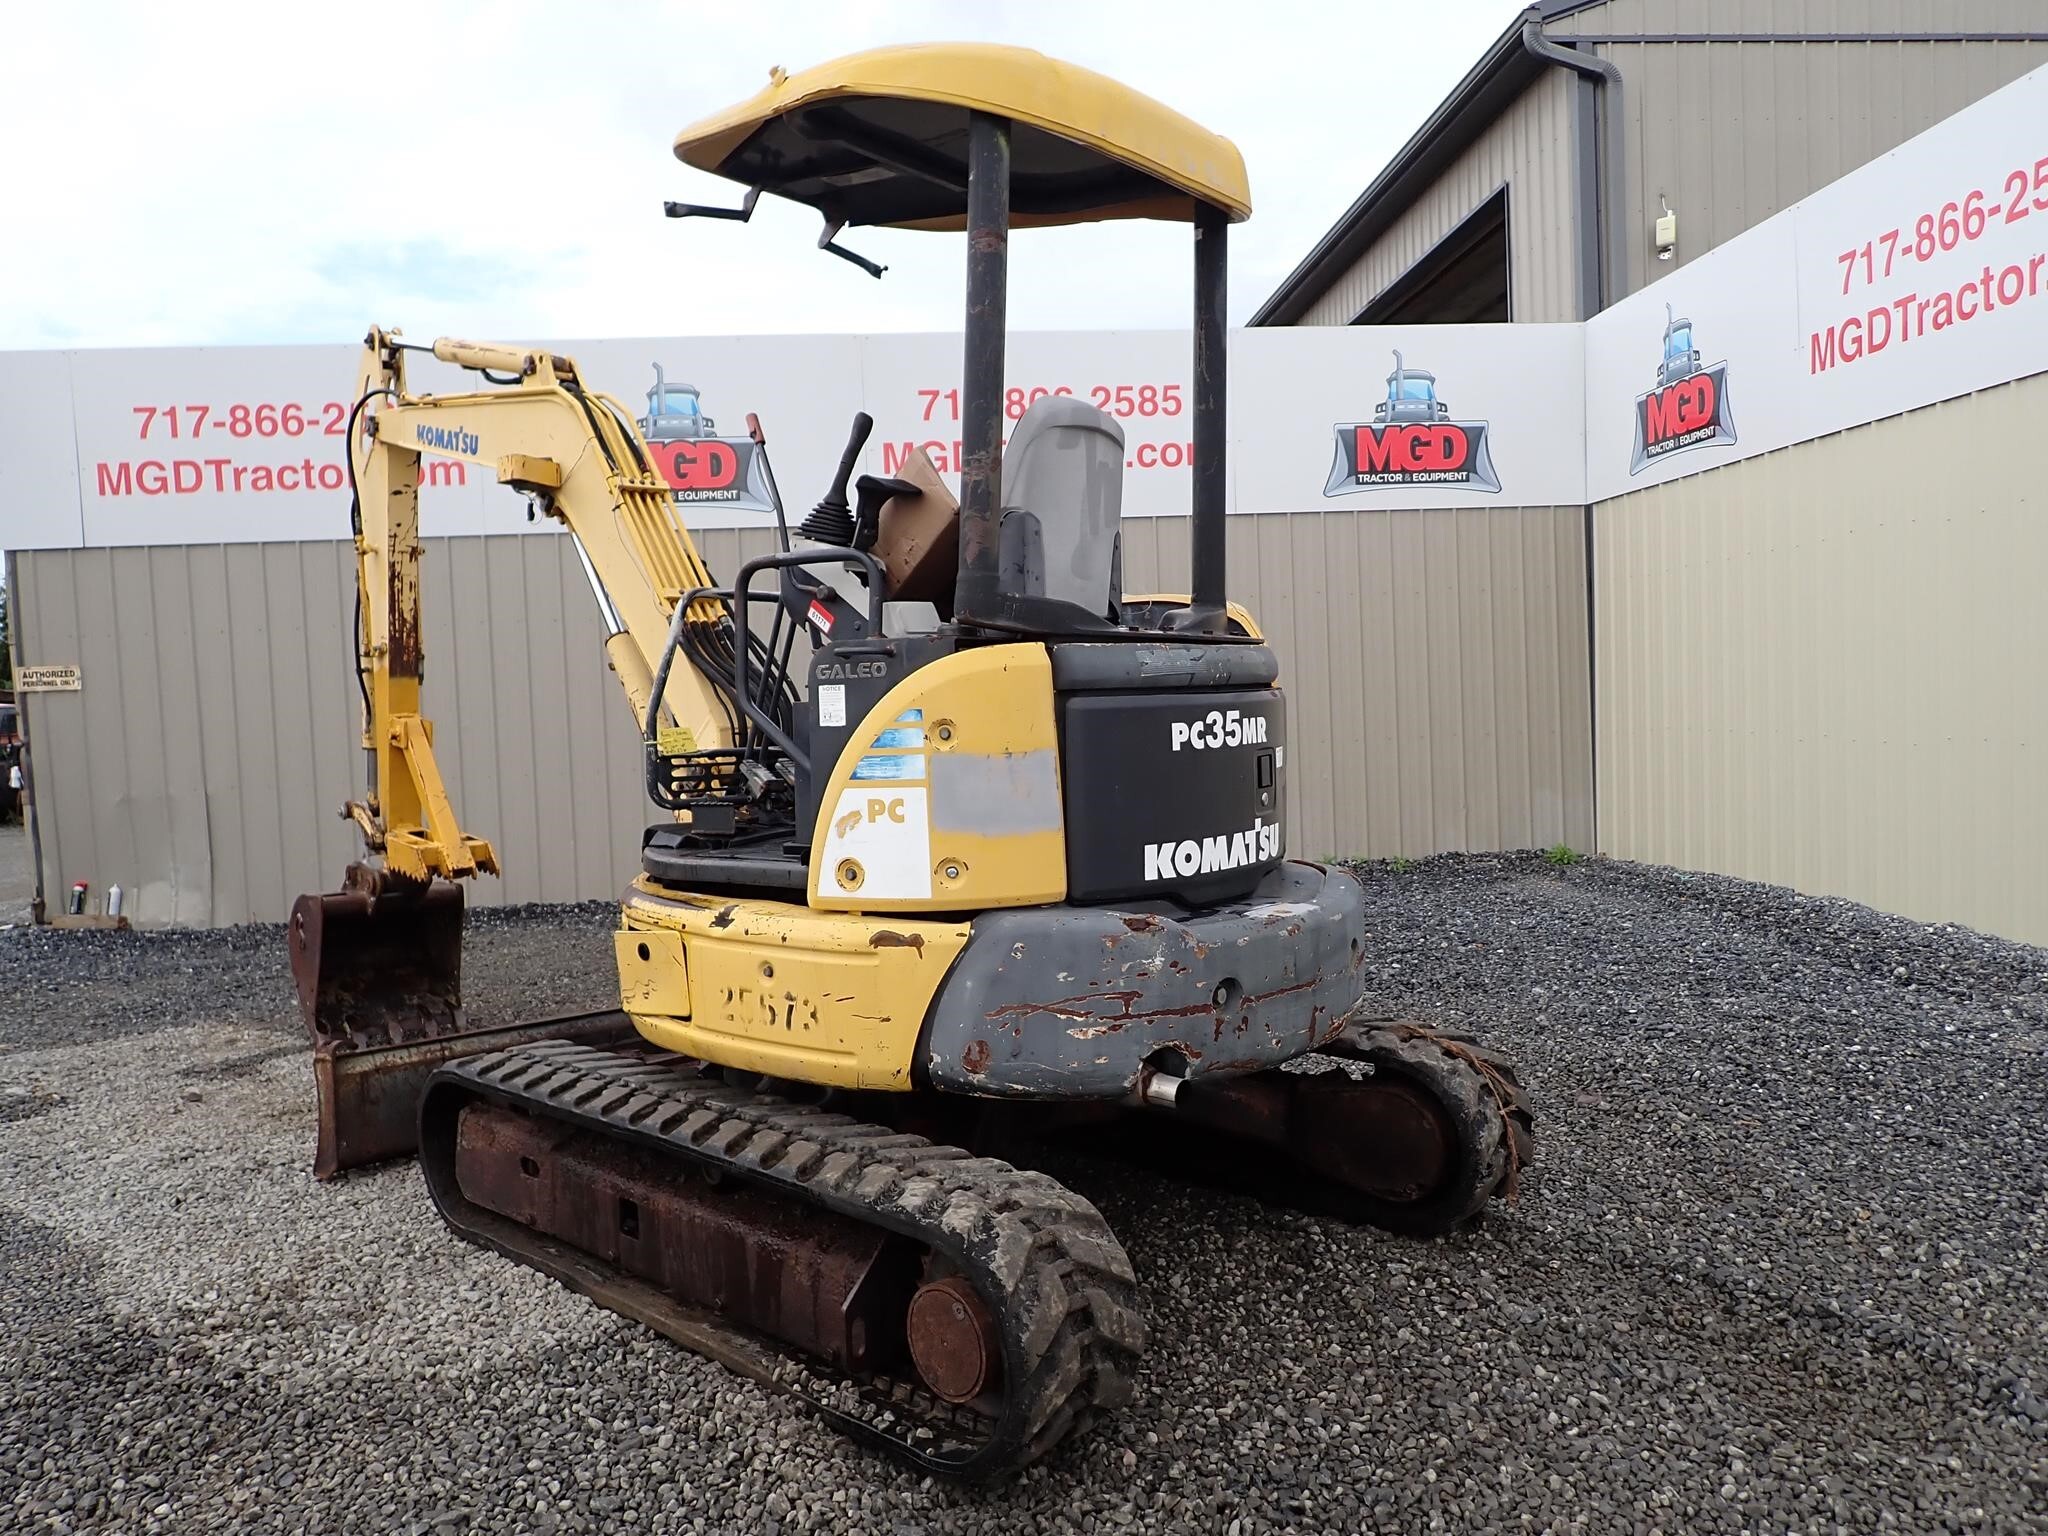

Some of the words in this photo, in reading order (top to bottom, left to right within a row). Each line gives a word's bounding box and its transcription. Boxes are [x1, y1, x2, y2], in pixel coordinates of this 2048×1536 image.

[1811, 254, 2048, 374] MGDTractor
[132, 402, 394, 439] 717-866-2
[1646, 373, 1714, 443] MGD
[417, 424, 478, 455] KOMATSU
[1355, 424, 1468, 472] MGD
[1648, 439, 1674, 456] TRACTOR
[1680, 426, 1715, 446] EQUIPMENT
[1357, 473, 1403, 483] TRACTOR
[1404, 473, 1411, 481] &
[1412, 471, 1468, 482] EQUIPMENT
[678, 490, 738, 500] EQUIPMENT
[22, 670, 76, 679] AUTHORIZED
[815, 661, 887, 679] GALEO
[1171, 710, 1267, 751] PC35MR
[867, 798, 905, 824] PC
[1144, 817, 1279, 881] KOMATSU
